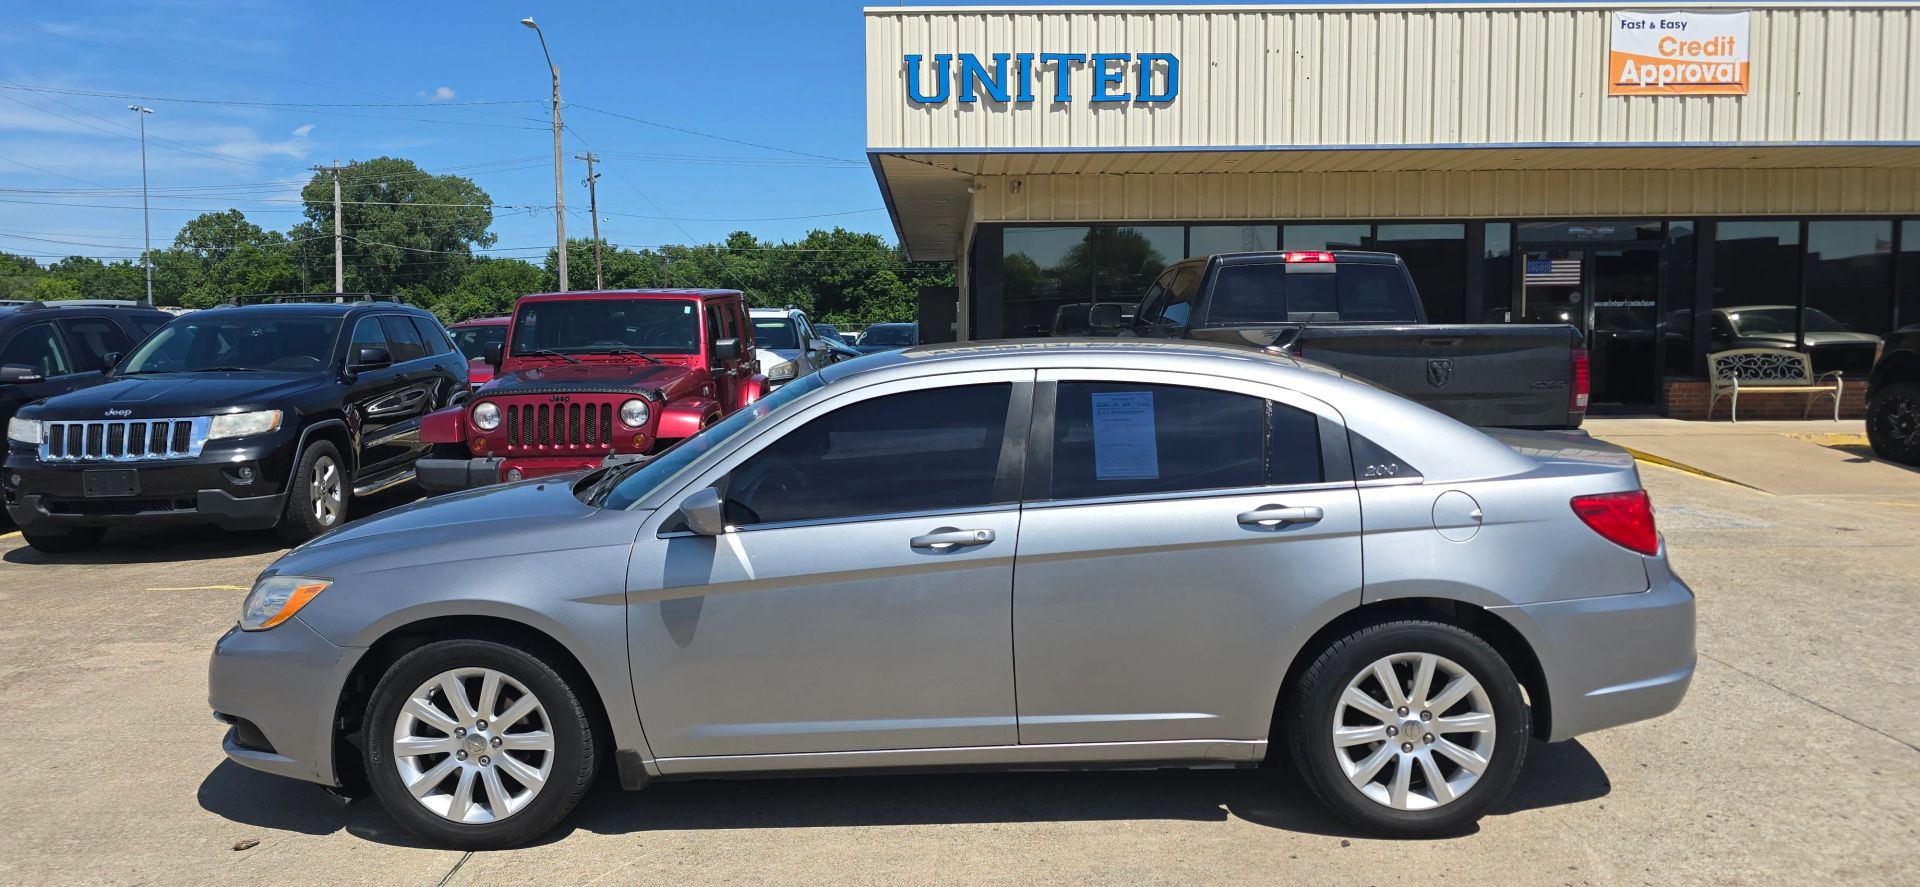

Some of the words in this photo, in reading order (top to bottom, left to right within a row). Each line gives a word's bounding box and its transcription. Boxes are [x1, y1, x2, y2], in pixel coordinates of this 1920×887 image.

[1621, 19, 1646, 30] Fast
[1649, 21, 1656, 30] &
[1660, 19, 1688, 31] Easy
[1658, 36, 1736, 57] Credit
[904, 53, 1179, 103] UNITED
[1620, 58, 1741, 87] Approval
[549, 395, 570, 404] Jeep
[104, 408, 132, 418] Jeep
[1364, 463, 1399, 477] 200
